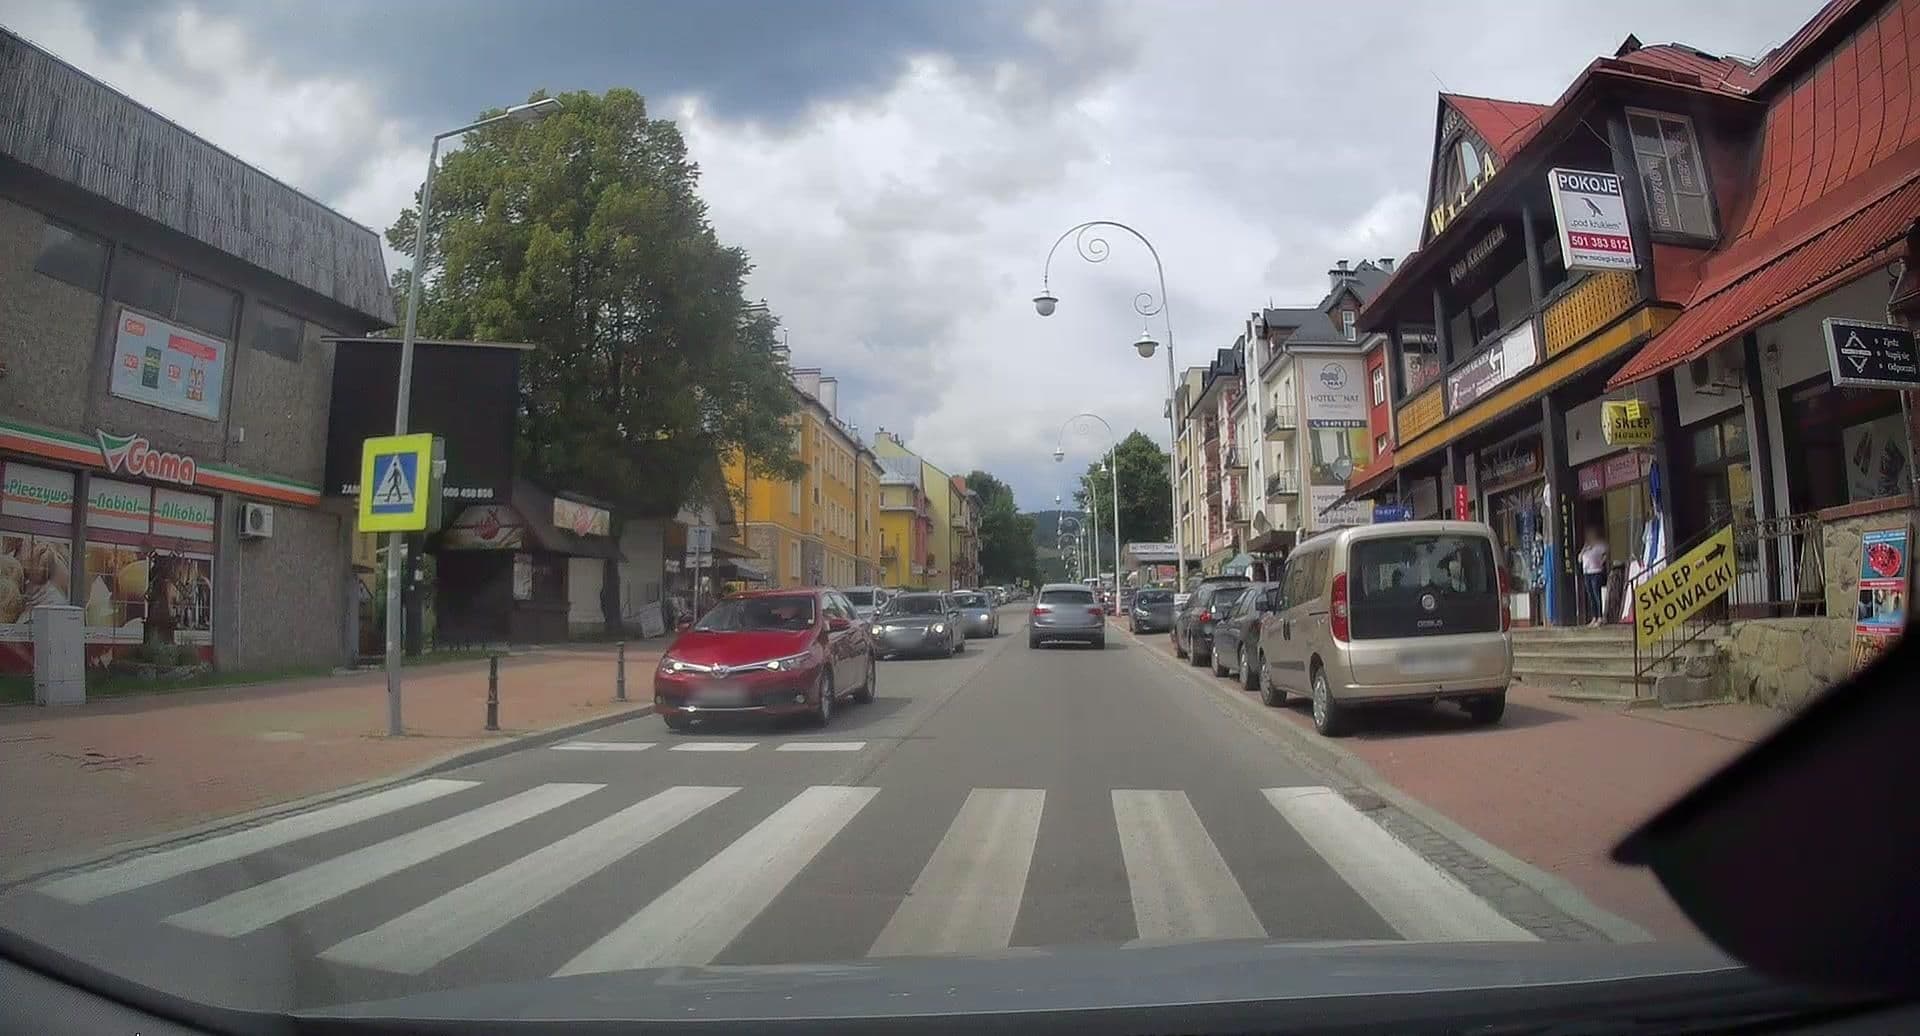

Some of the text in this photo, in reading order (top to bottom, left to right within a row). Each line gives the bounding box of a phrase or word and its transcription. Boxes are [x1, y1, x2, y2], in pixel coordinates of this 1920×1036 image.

[1431, 152, 1496, 235] WILLA
[1559, 174, 1619, 193] POKOJE
[1571, 235, 1629, 250] 501 383 812
[1310, 394, 1336, 402] HOTEL
[1615, 417, 1651, 429] SKLEP
[127, 438, 195, 485] Gama
[8, 479, 70, 506] Pieczywo
[161, 502, 208, 522] Alkohol
[1639, 565, 1692, 610] SKLEP
[1642, 563, 1734, 636] SŁOWACKI
